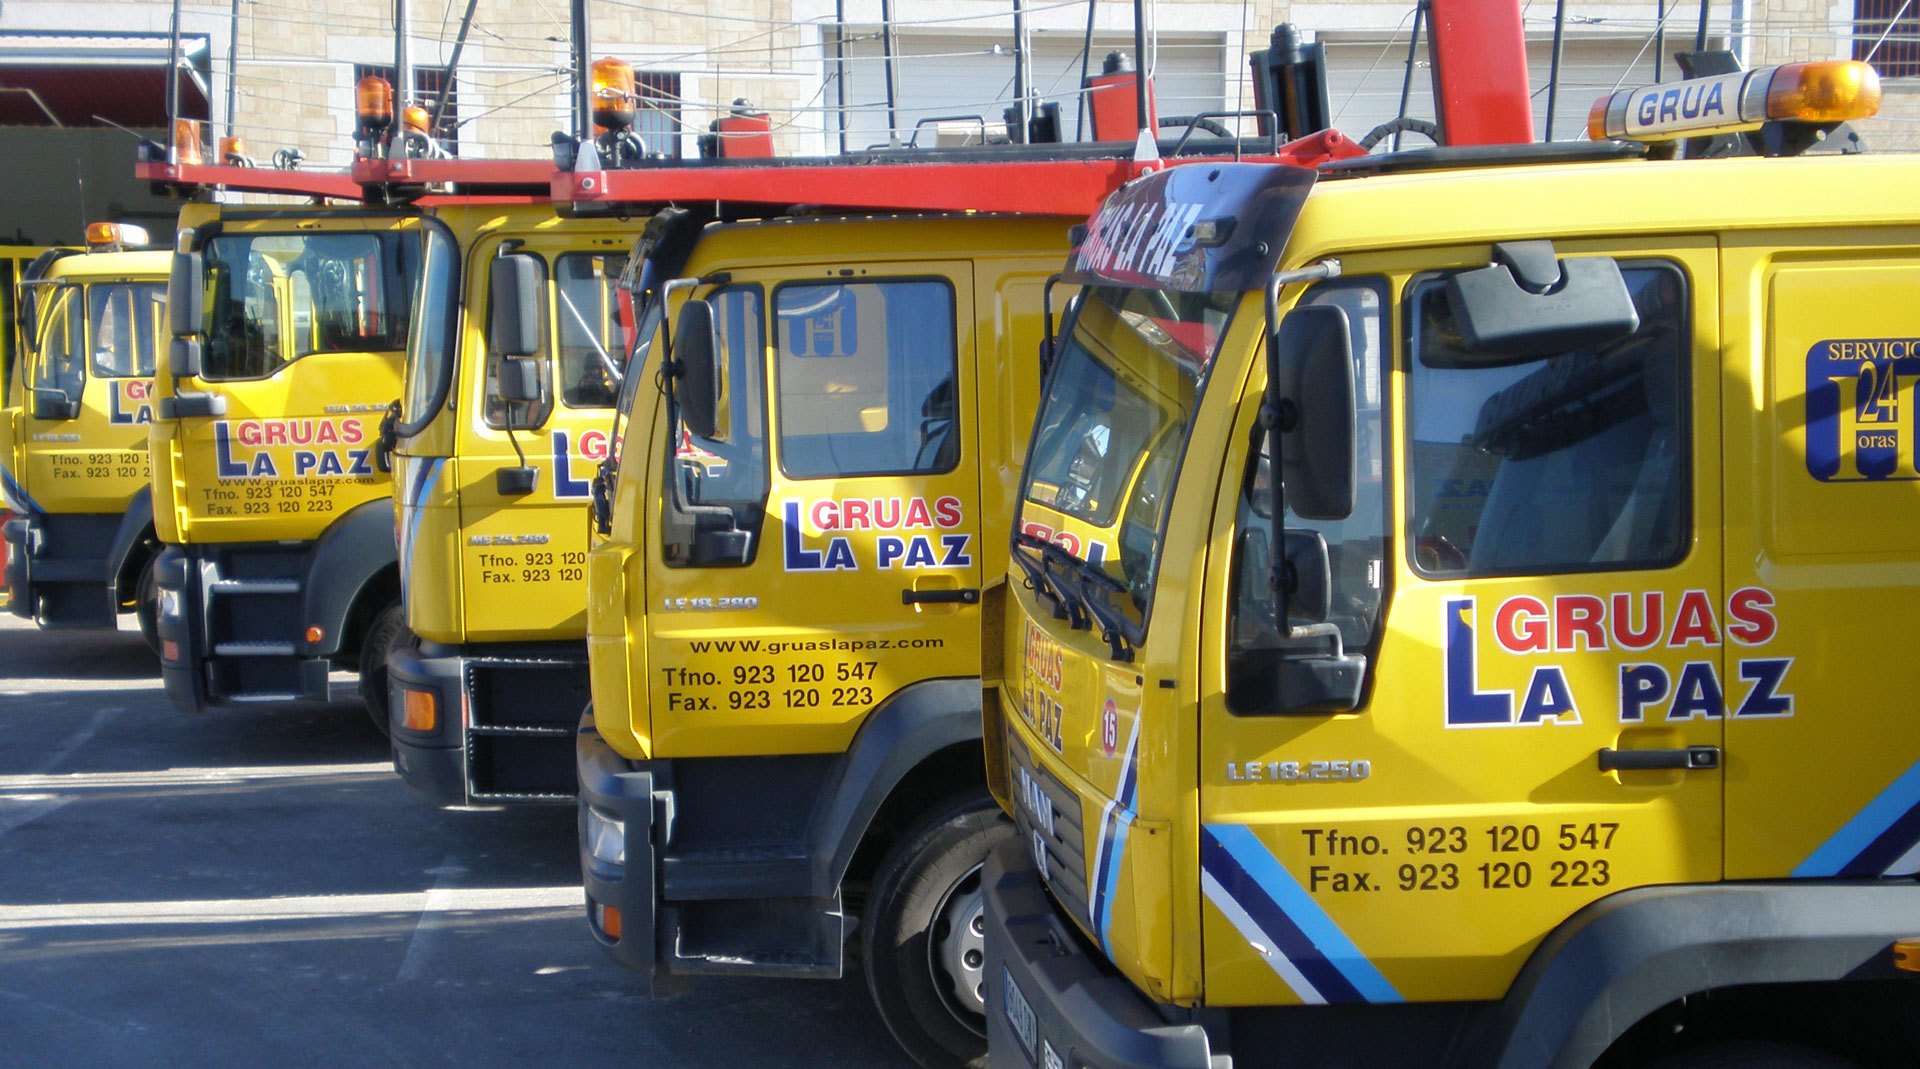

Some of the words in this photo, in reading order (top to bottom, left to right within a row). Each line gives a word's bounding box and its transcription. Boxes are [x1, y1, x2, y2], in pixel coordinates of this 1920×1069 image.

[1638, 82, 1724, 127] GRUA
[1113, 202, 1158, 272] LA
[1138, 203, 1204, 277] PAZ
[1859, 360, 1898, 422] 24
[214, 420, 279, 479] LA
[294, 449, 373, 477] PAZ
[238, 419, 363, 446] GRUAS
[1858, 435, 1896, 449] oras
[50, 455, 83, 465] Tfno.
[88, 453, 112, 465] 923
[120, 453, 139, 464] 120
[53, 468, 81, 478] Fax.
[86, 467, 110, 478] 923
[116, 467, 137, 478] 120
[203, 488, 239, 500] Tfno.
[246, 487, 272, 499] 923
[280, 486, 302, 498] 120
[309, 485, 335, 497] 547
[207, 504, 237, 515] Fax.
[244, 502, 270, 514] 923
[277, 501, 300, 513] 120
[307, 500, 333, 512] 223
[809, 495, 962, 532] GRUAS
[781, 497, 858, 572] LA
[876, 533, 973, 571] PAZ
[479, 554, 518, 567] Tfno.
[525, 553, 553, 566] 923
[560, 552, 586, 564] 120
[483, 571, 515, 583] Fax.
[522, 569, 550, 582] 923
[559, 568, 583, 581] 120
[664, 598, 688, 611] LE
[689, 596, 758, 611] 18.280
[1493, 585, 1778, 654] GRUAS
[662, 667, 722, 686] Tfno.
[733, 665, 775, 684] 923
[787, 663, 825, 683] 120
[837, 661, 878, 681] 547
[1028, 624, 1063, 694] GRUAS
[1442, 595, 1582, 729] LA
[1619, 656, 1795, 722] PAZ
[669, 692, 717, 711] Fax.
[729, 690, 771, 709] 923
[782, 688, 820, 708] 120
[832, 686, 874, 706] 223
[1039, 690, 1063, 756] PAZ
[1104, 710, 1116, 747] 15
[1228, 762, 1262, 782] LE
[1267, 760, 1371, 781] 18.250
[1302, 828, 1389, 857] Tfno.
[1406, 826, 1468, 854] 923
[1485, 824, 1541, 852] 120
[1558, 821, 1620, 850] 547
[1310, 865, 1381, 893] Fax.
[1399, 862, 1460, 891] 923
[1478, 861, 1532, 889] 120
[1549, 858, 1611, 887] 223
